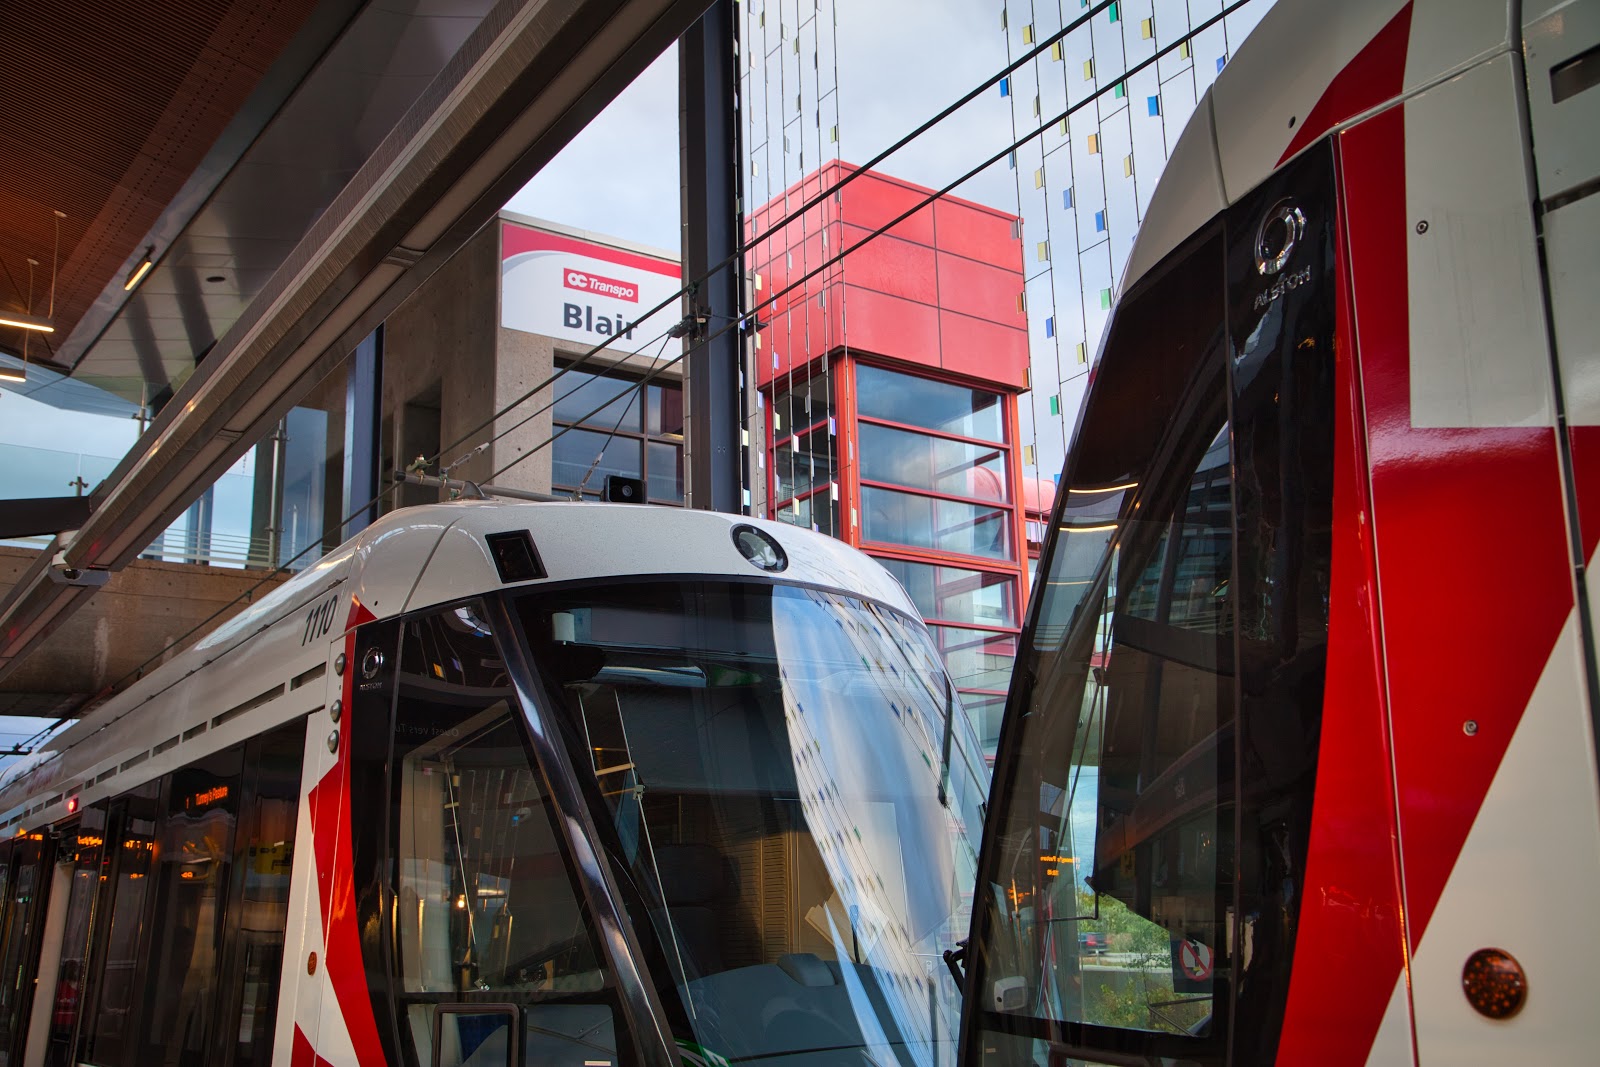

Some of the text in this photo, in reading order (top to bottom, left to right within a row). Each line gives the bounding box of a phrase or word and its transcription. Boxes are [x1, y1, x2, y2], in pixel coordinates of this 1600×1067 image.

[567, 272, 634, 298] OC Transpo
[563, 302, 638, 340] Blair
[302, 595, 338, 646] 1110
